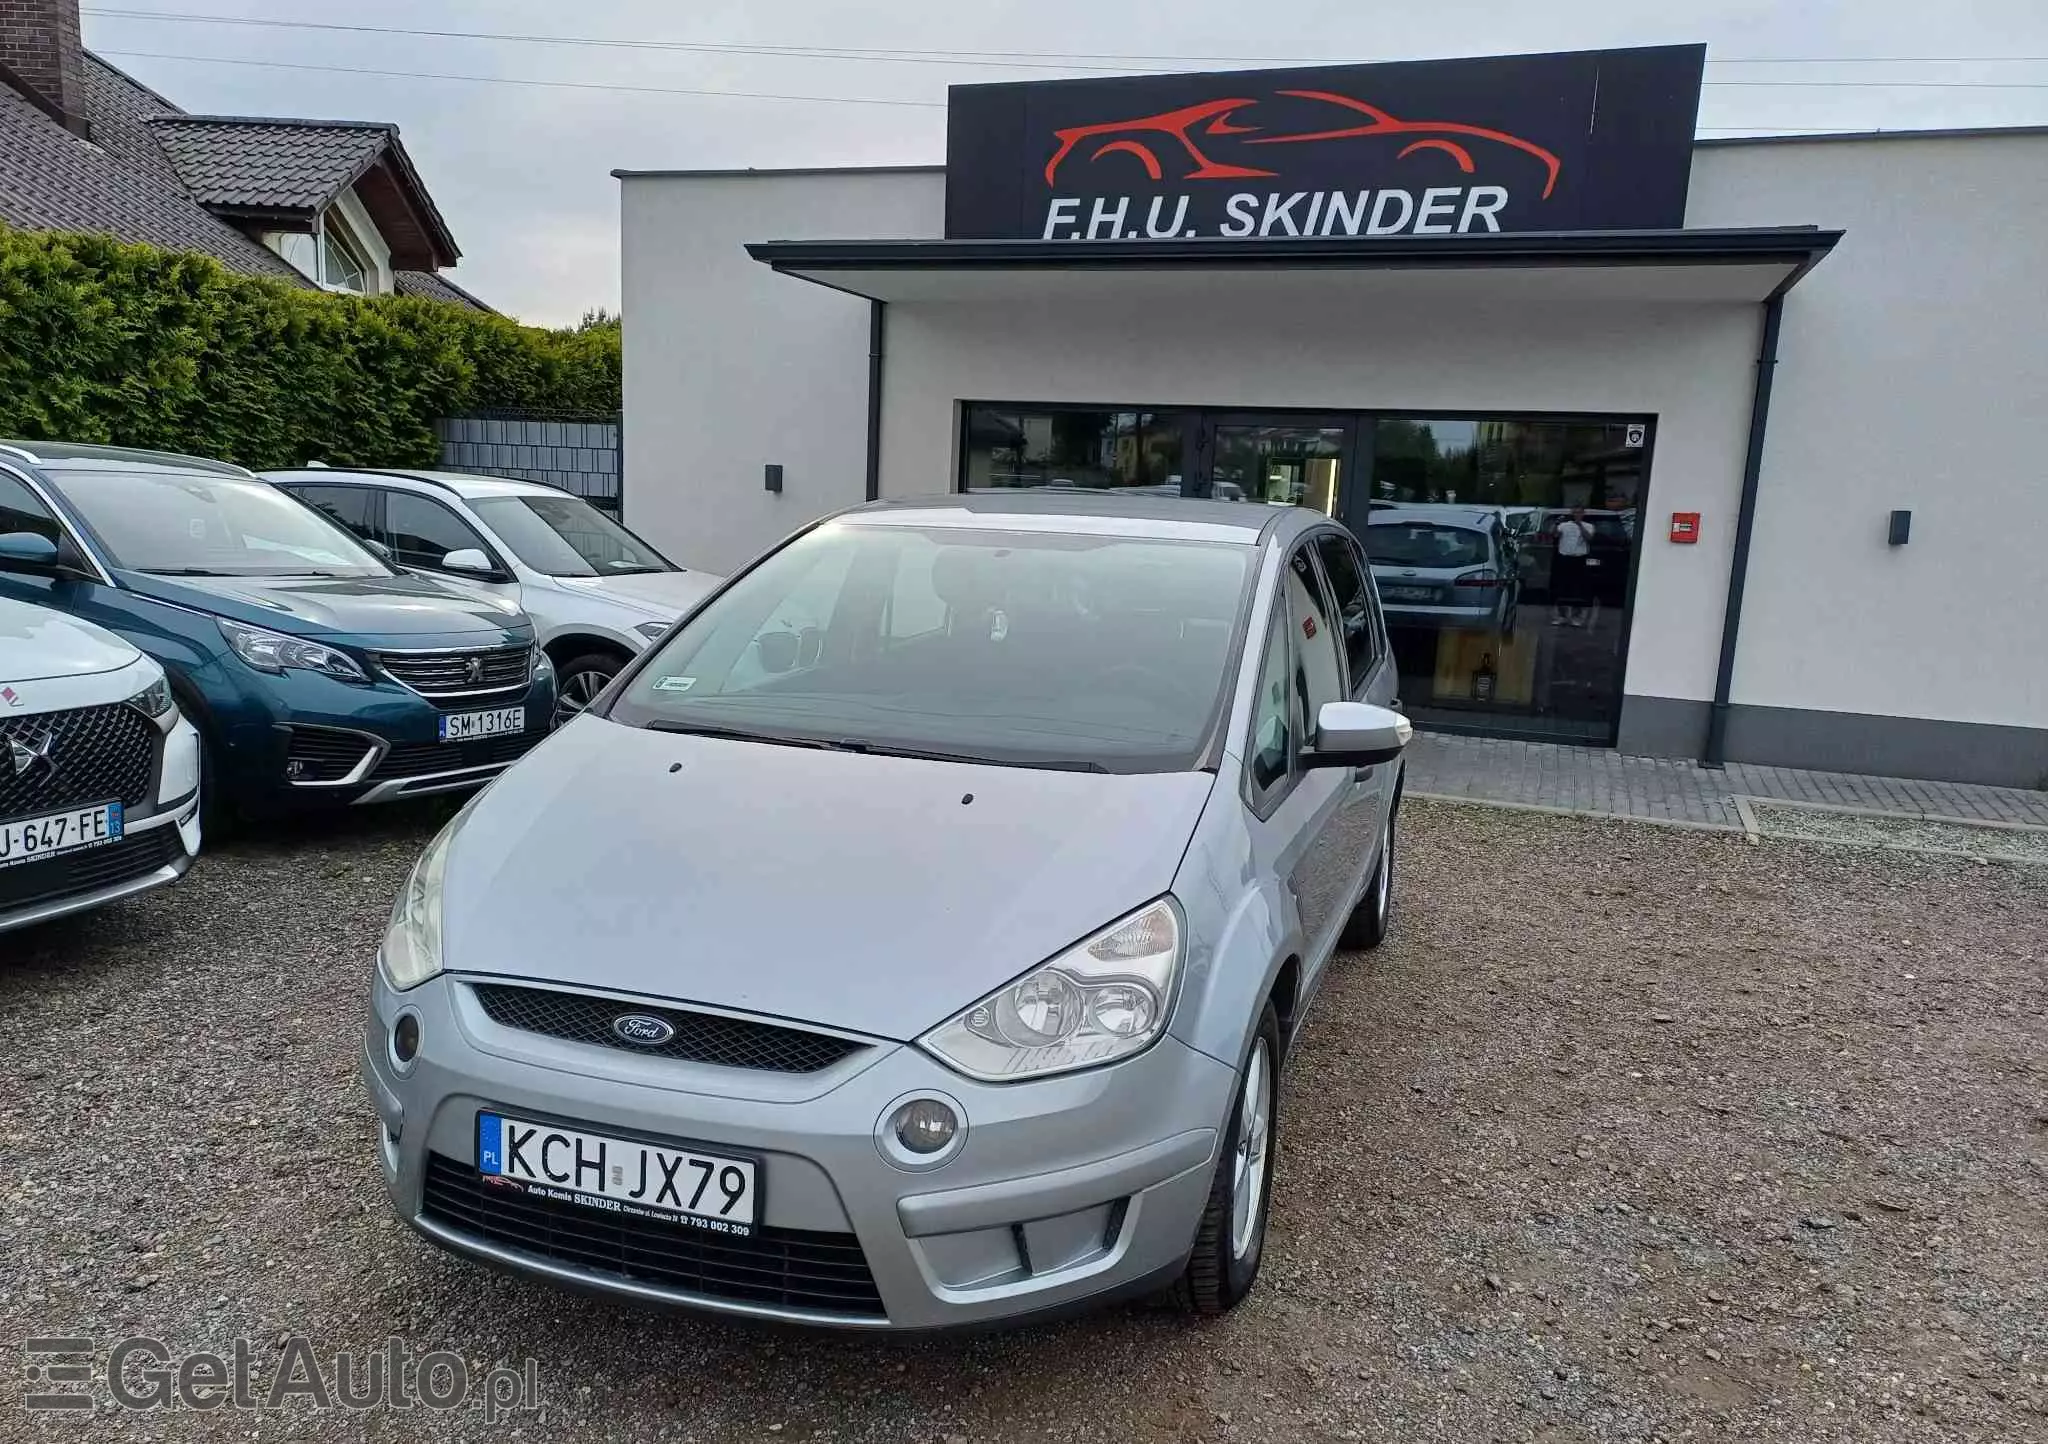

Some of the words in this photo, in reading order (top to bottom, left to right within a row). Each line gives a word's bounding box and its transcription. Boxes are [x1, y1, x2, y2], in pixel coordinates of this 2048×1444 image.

[1043, 195, 1197, 240] F.H.U.
[1219, 186, 1509, 237] SKINDER
[450, 716, 470, 736] SM
[478, 709, 521, 733] 1316E
[624, 1019, 659, 1039] Ford
[483, 1150, 499, 1165] PL
[508, 1125, 606, 1192] KCH
[628, 1150, 746, 1216] JX79
[528, 1185, 546, 1197] Auto
[574, 1193, 621, 1212] SKINDER
[690, 1218, 708, 1229] 793
[710, 1221, 729, 1233] 002
[731, 1226, 750, 1237] 309
